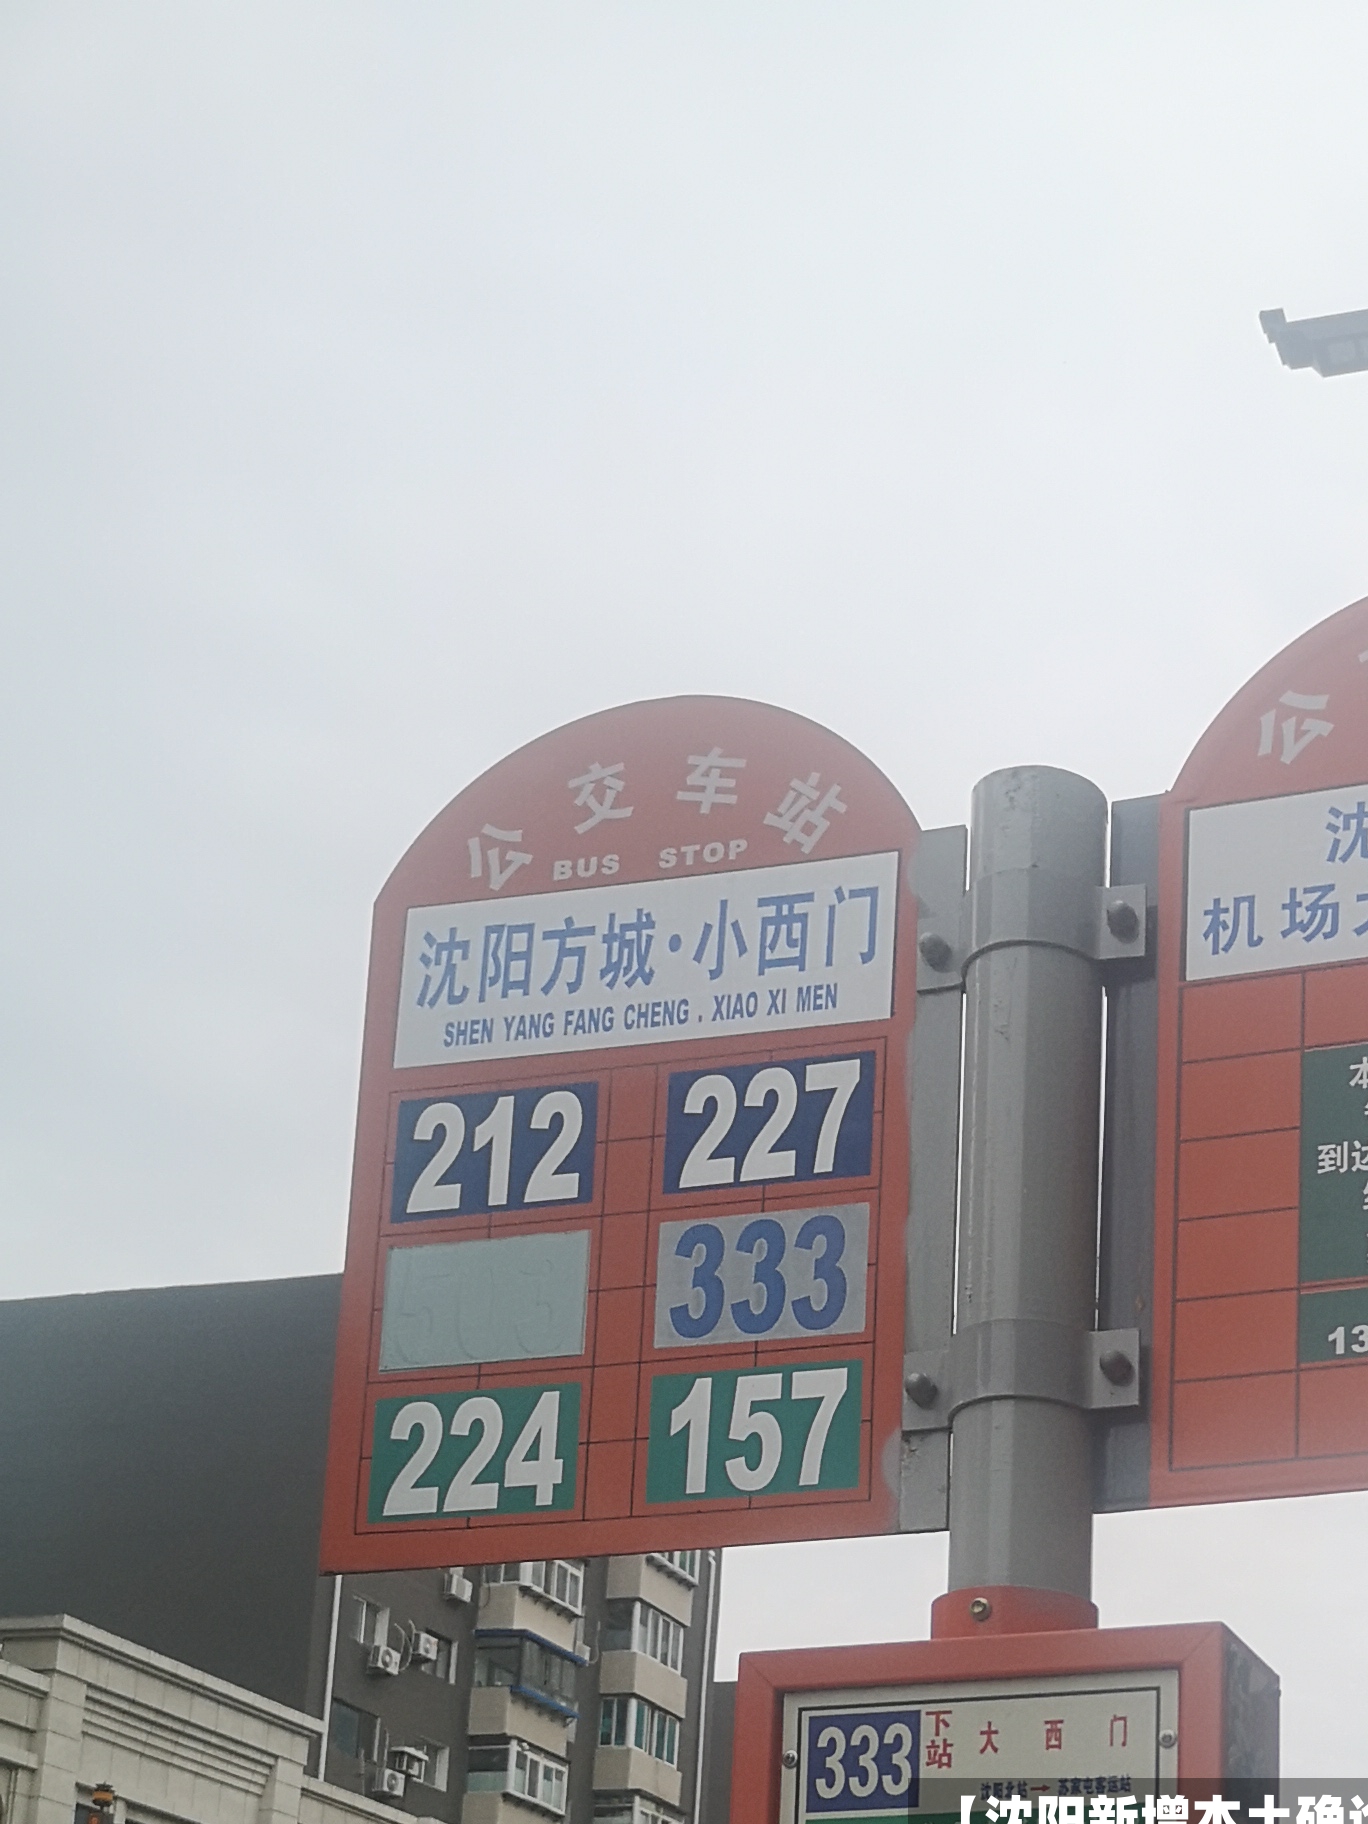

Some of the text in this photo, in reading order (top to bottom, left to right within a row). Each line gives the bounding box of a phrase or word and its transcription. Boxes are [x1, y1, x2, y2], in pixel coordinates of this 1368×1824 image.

[468, 747, 848, 891] 公交车站
[553, 839, 748, 880] BUS STOP
[415, 886, 879, 1009] 沈阳方城·小西门
[443, 983, 837, 1047] SHEN YANG FANG CHENG XIAO XI MEN
[406, 1090, 583, 1213] 212
[679, 1059, 861, 1189] 227
[669, 1215, 848, 1339] 333
[382, 1391, 564, 1516] 224
[670, 1367, 849, 1494] 157
[815, 1722, 913, 1800] 333
[925, 1710, 953, 1769] 下站
[979, 1714, 1128, 1754] 大西门
